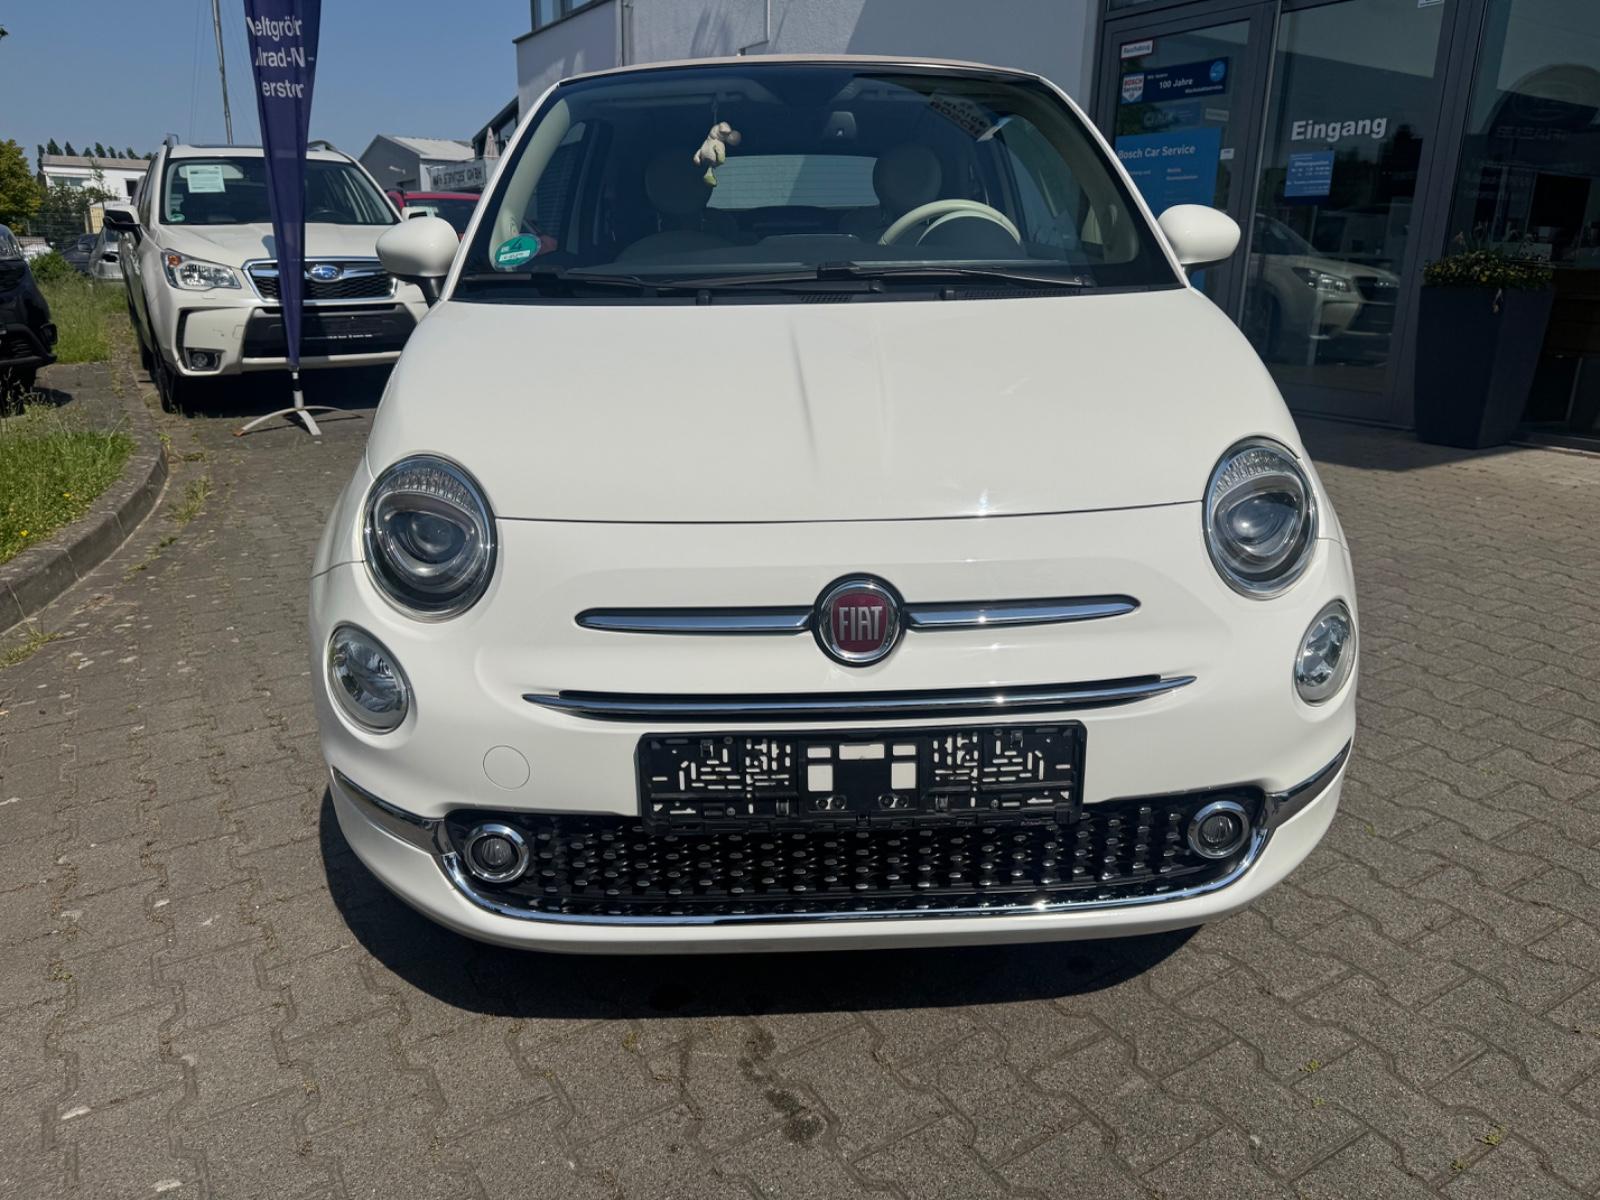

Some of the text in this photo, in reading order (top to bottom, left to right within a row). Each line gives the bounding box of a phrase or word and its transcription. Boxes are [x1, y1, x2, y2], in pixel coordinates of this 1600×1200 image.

[1160, 78, 1193, 89] 100 Jahre
[1291, 117, 1387, 142] Eingang
[1118, 143, 1196, 160] Bosch Car Service
[839, 605, 883, 641] FIAT
